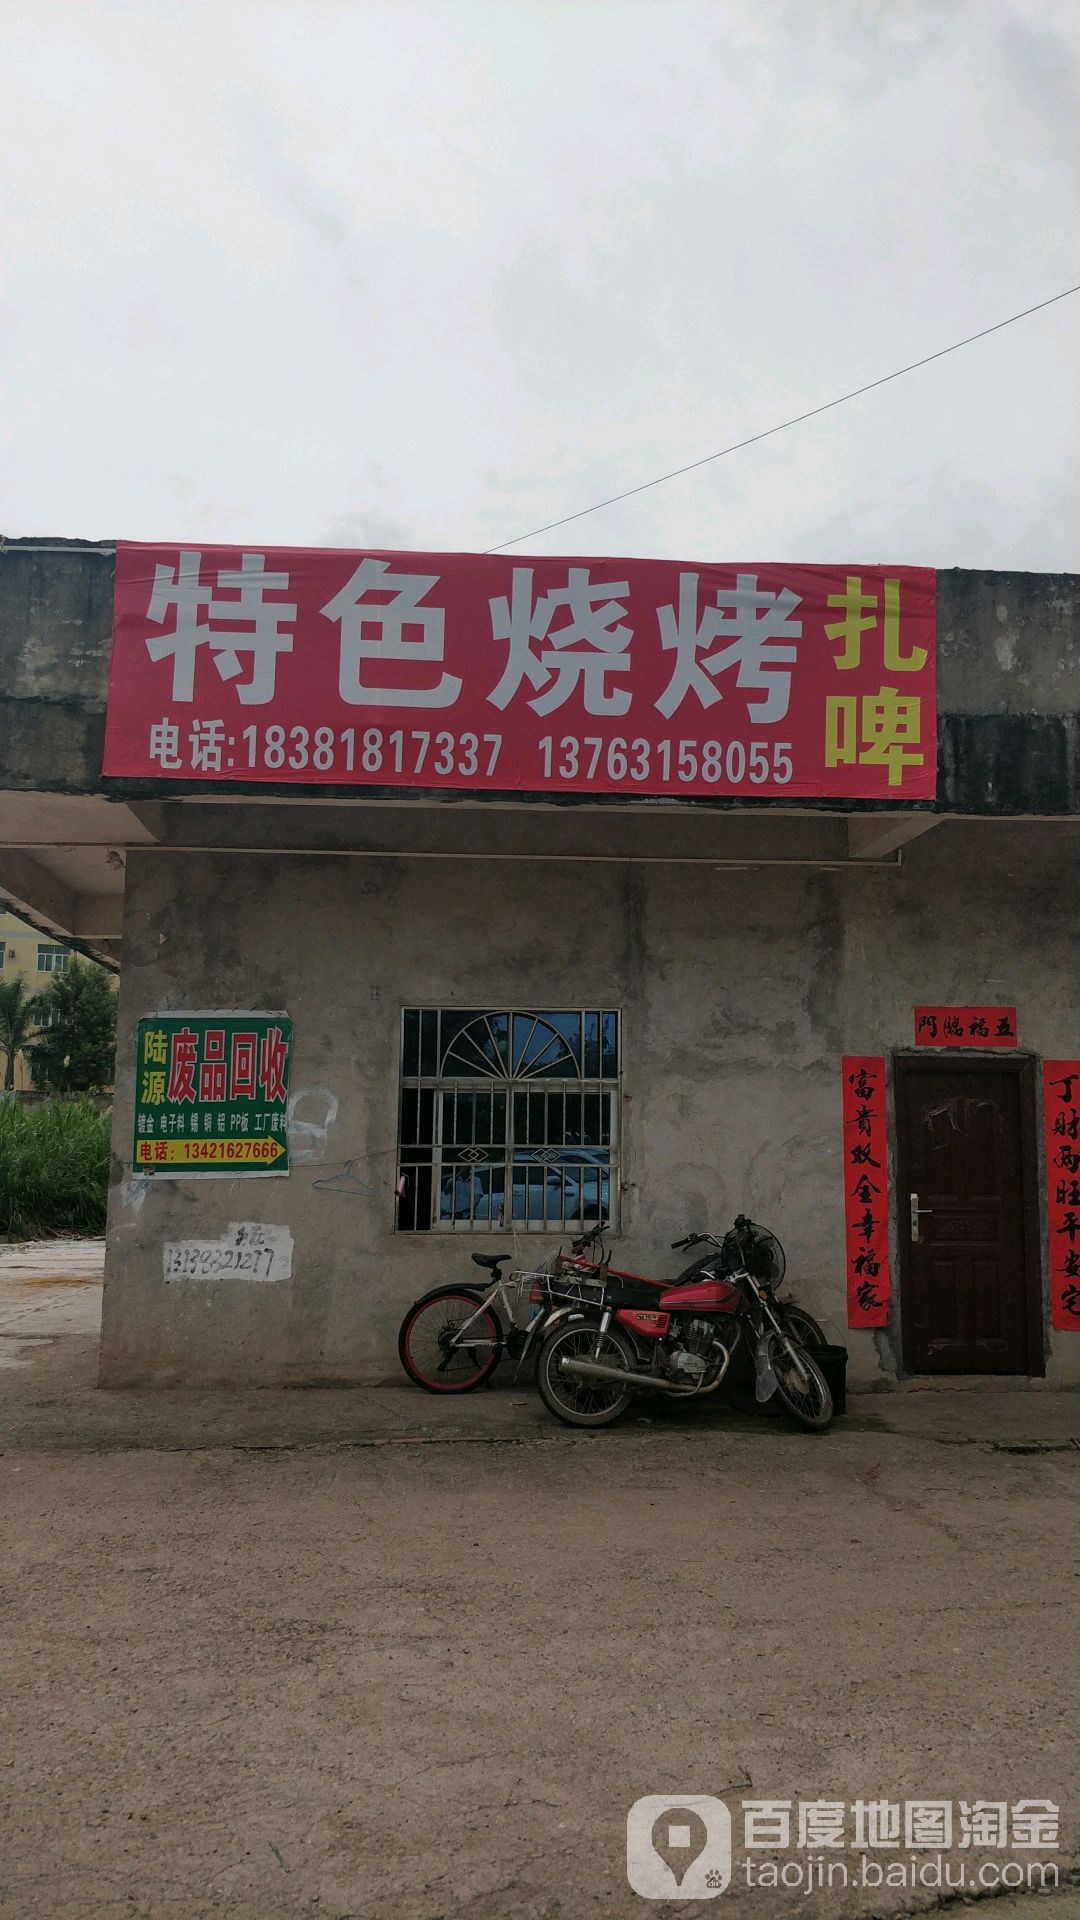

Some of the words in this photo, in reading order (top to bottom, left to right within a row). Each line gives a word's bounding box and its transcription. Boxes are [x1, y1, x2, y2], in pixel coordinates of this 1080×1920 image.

[145, 551, 803, 724] 特色烧烤
[823, 576, 928, 786] 扎啤
[538, 735, 793, 784] 13763158055
[141, 1029, 168, 1106] 陆源
[167, 1026, 288, 1105] 废品回收
[160, 1112, 185, 1133] 电子料
[230, 1112, 249, 1133] PP板
[254, 1111, 287, 1132] 工厂废料
[184, 1142, 278, 1159] 13421627666
